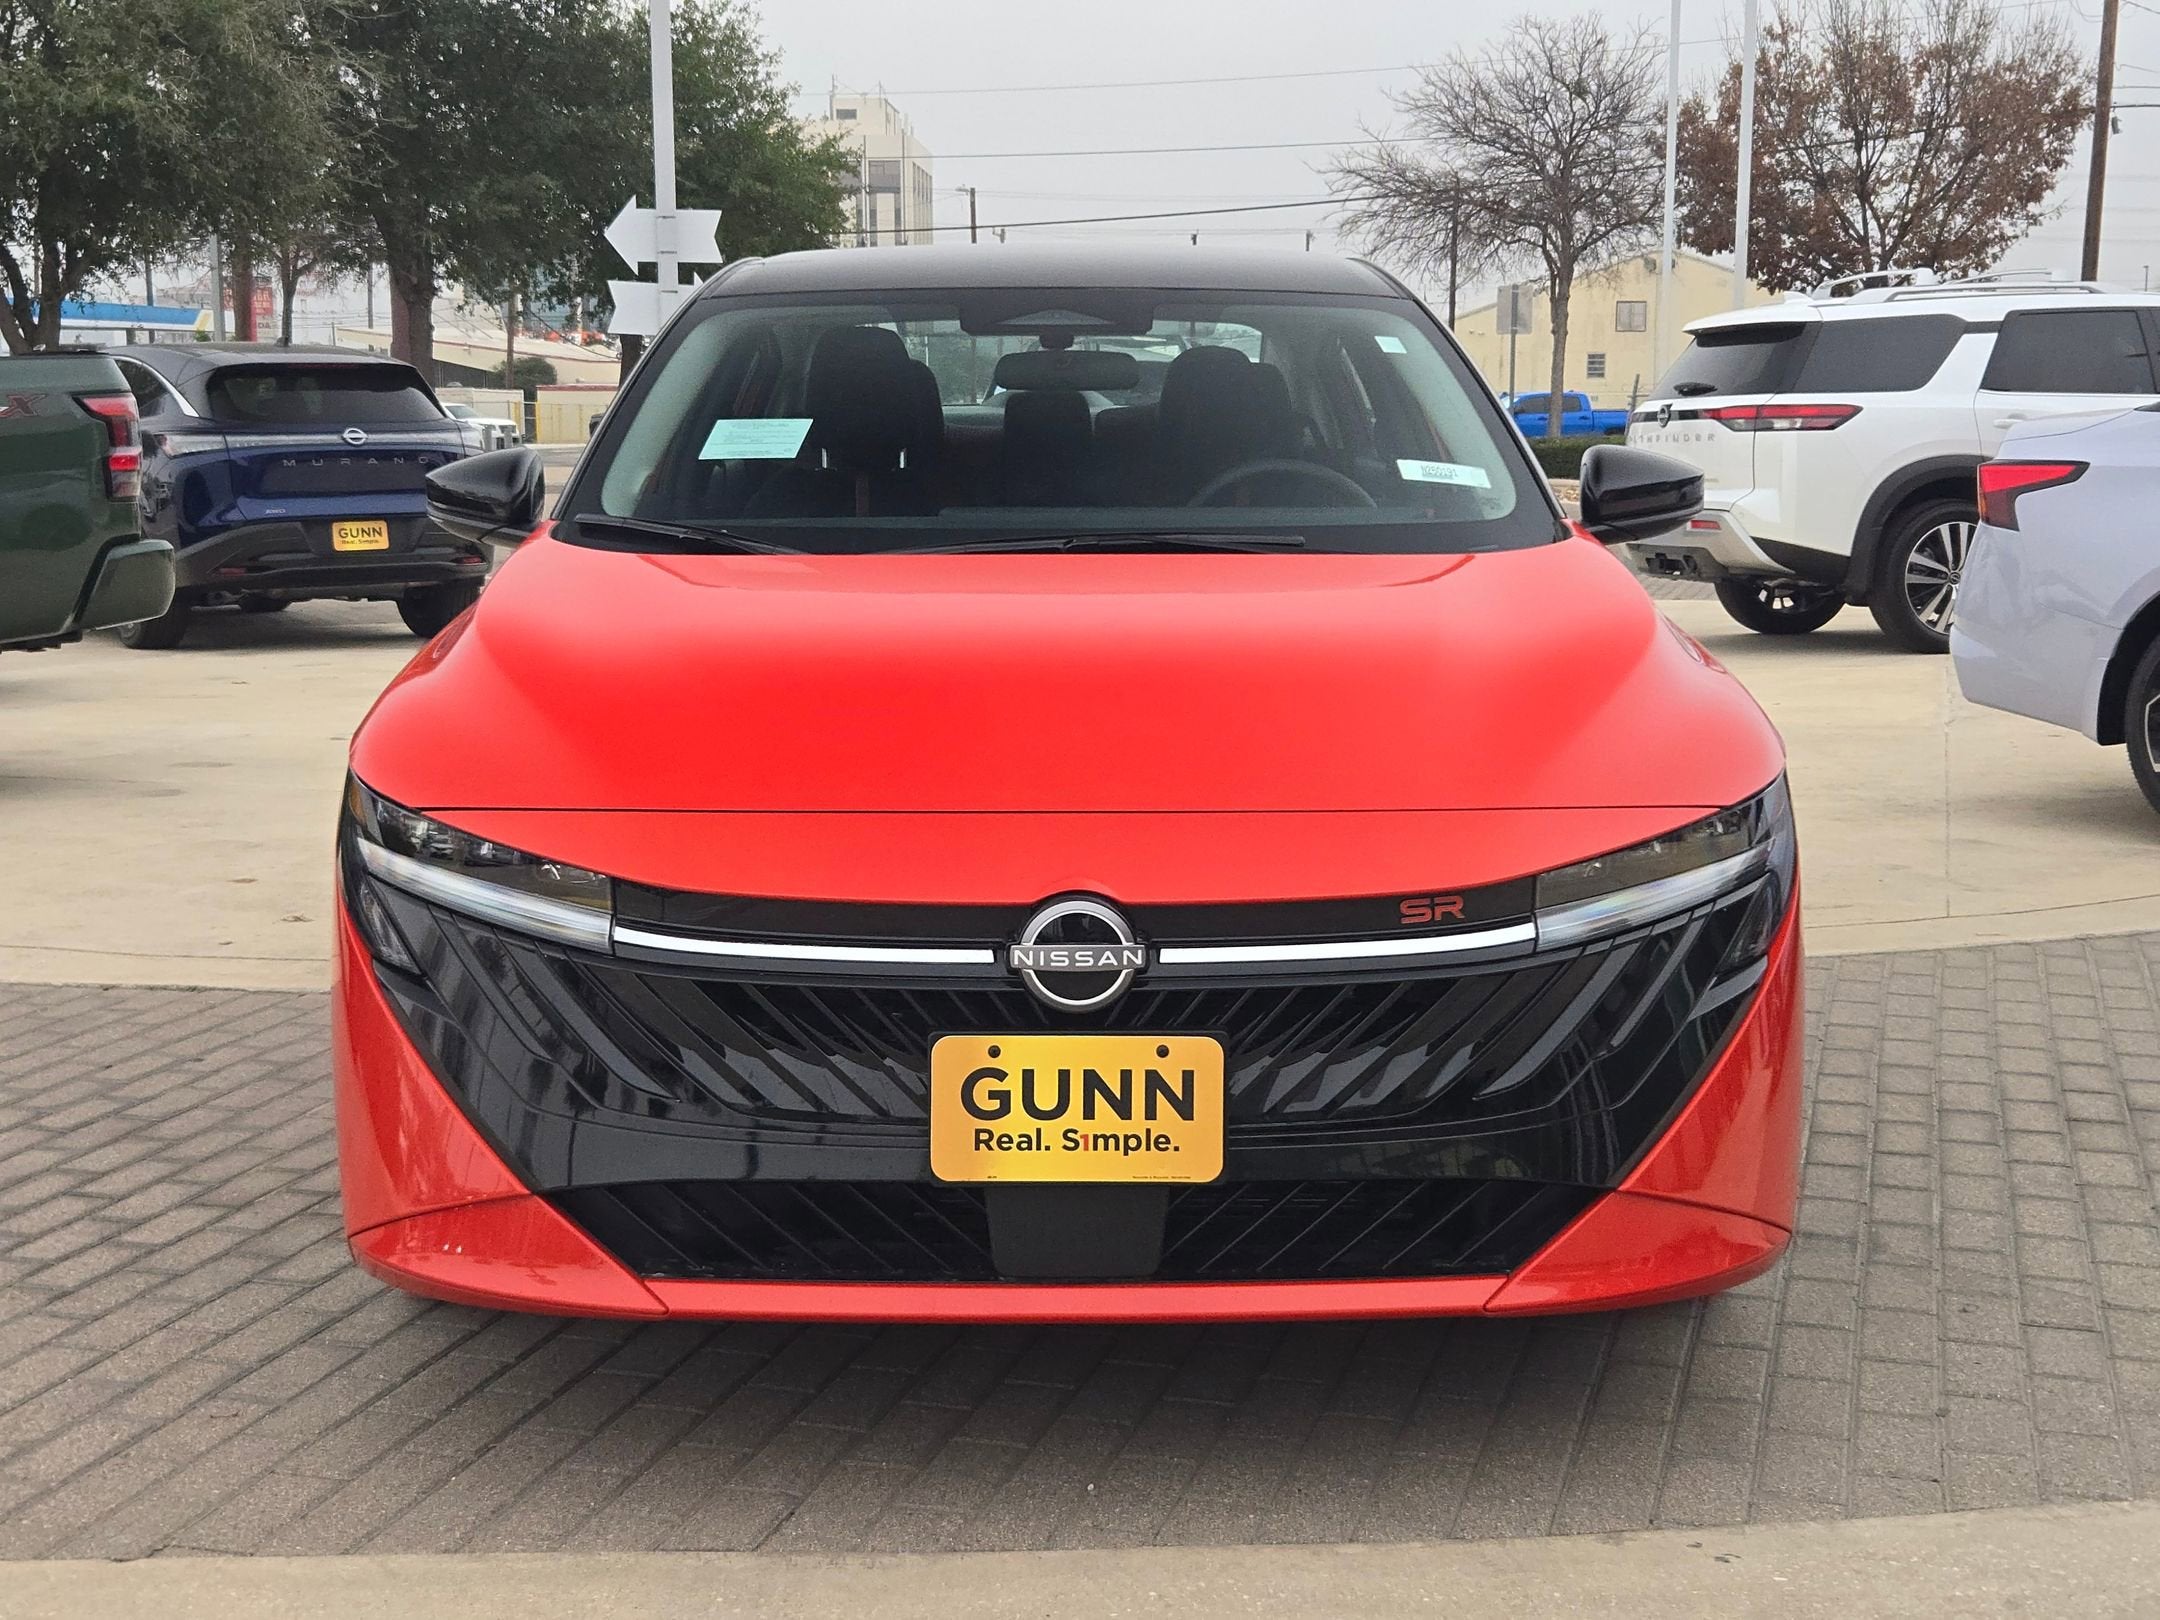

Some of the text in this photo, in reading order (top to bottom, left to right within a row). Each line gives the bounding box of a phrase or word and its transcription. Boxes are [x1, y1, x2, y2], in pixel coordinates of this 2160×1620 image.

[283, 456, 429, 467] MURANO
[339, 527, 383, 539] GUNN
[1400, 895, 1465, 924] SR
[1013, 949, 1142, 967] NISSAN
[960, 1067, 1195, 1121] GUNN
[974, 1127, 1051, 1152] Real.
